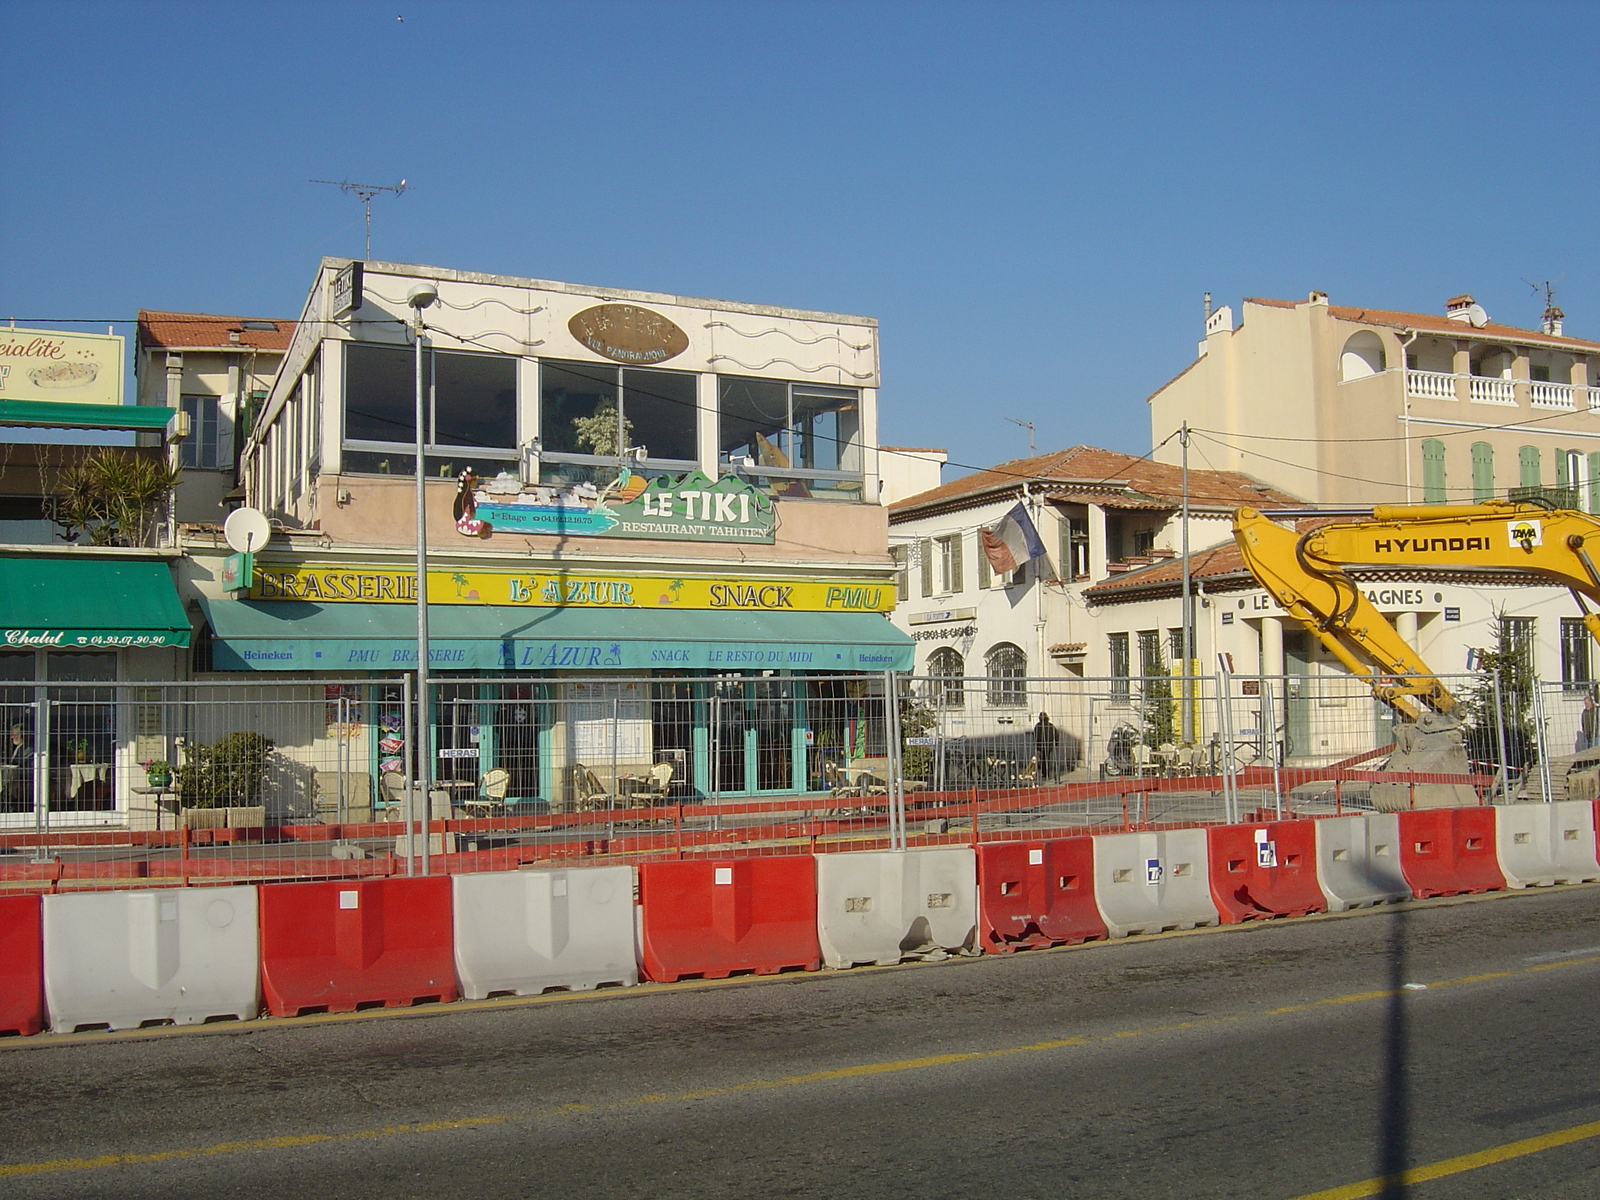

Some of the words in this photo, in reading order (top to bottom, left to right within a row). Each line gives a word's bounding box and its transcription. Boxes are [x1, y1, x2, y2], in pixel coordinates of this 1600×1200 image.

[642, 492, 673, 517] LE
[680, 490, 750, 523] TIKI
[501, 512, 527, 523] Etage
[622, 522, 706, 536] RESTAURANT
[709, 526, 769, 538] TAHITIEN
[1511, 528, 1537, 540] TAMA
[1374, 537, 1491, 553] HYUNDAI
[509, 577, 635, 604] L'AZUR
[709, 583, 794, 608] SNACK
[825, 586, 882, 610] PMU
[1361, 589, 1424, 605] AGNES
[1253, 595, 1269, 610] LE
[5, 630, 65, 645] Chalut
[90, 635, 166, 646] 04.93.07.90.90
[244, 650, 293, 660] Heineken
[348, 650, 380, 662] PMU
[651, 649, 690, 662] SNACK
[708, 651, 722, 662] LE
[726, 651, 764, 662] RESTO
[767, 651, 784, 662] DU
[788, 651, 814, 663] MIDI
[859, 653, 893, 663] Heineken
[908, 737, 934, 746] HERAS
[442, 749, 477, 758] HERAS
